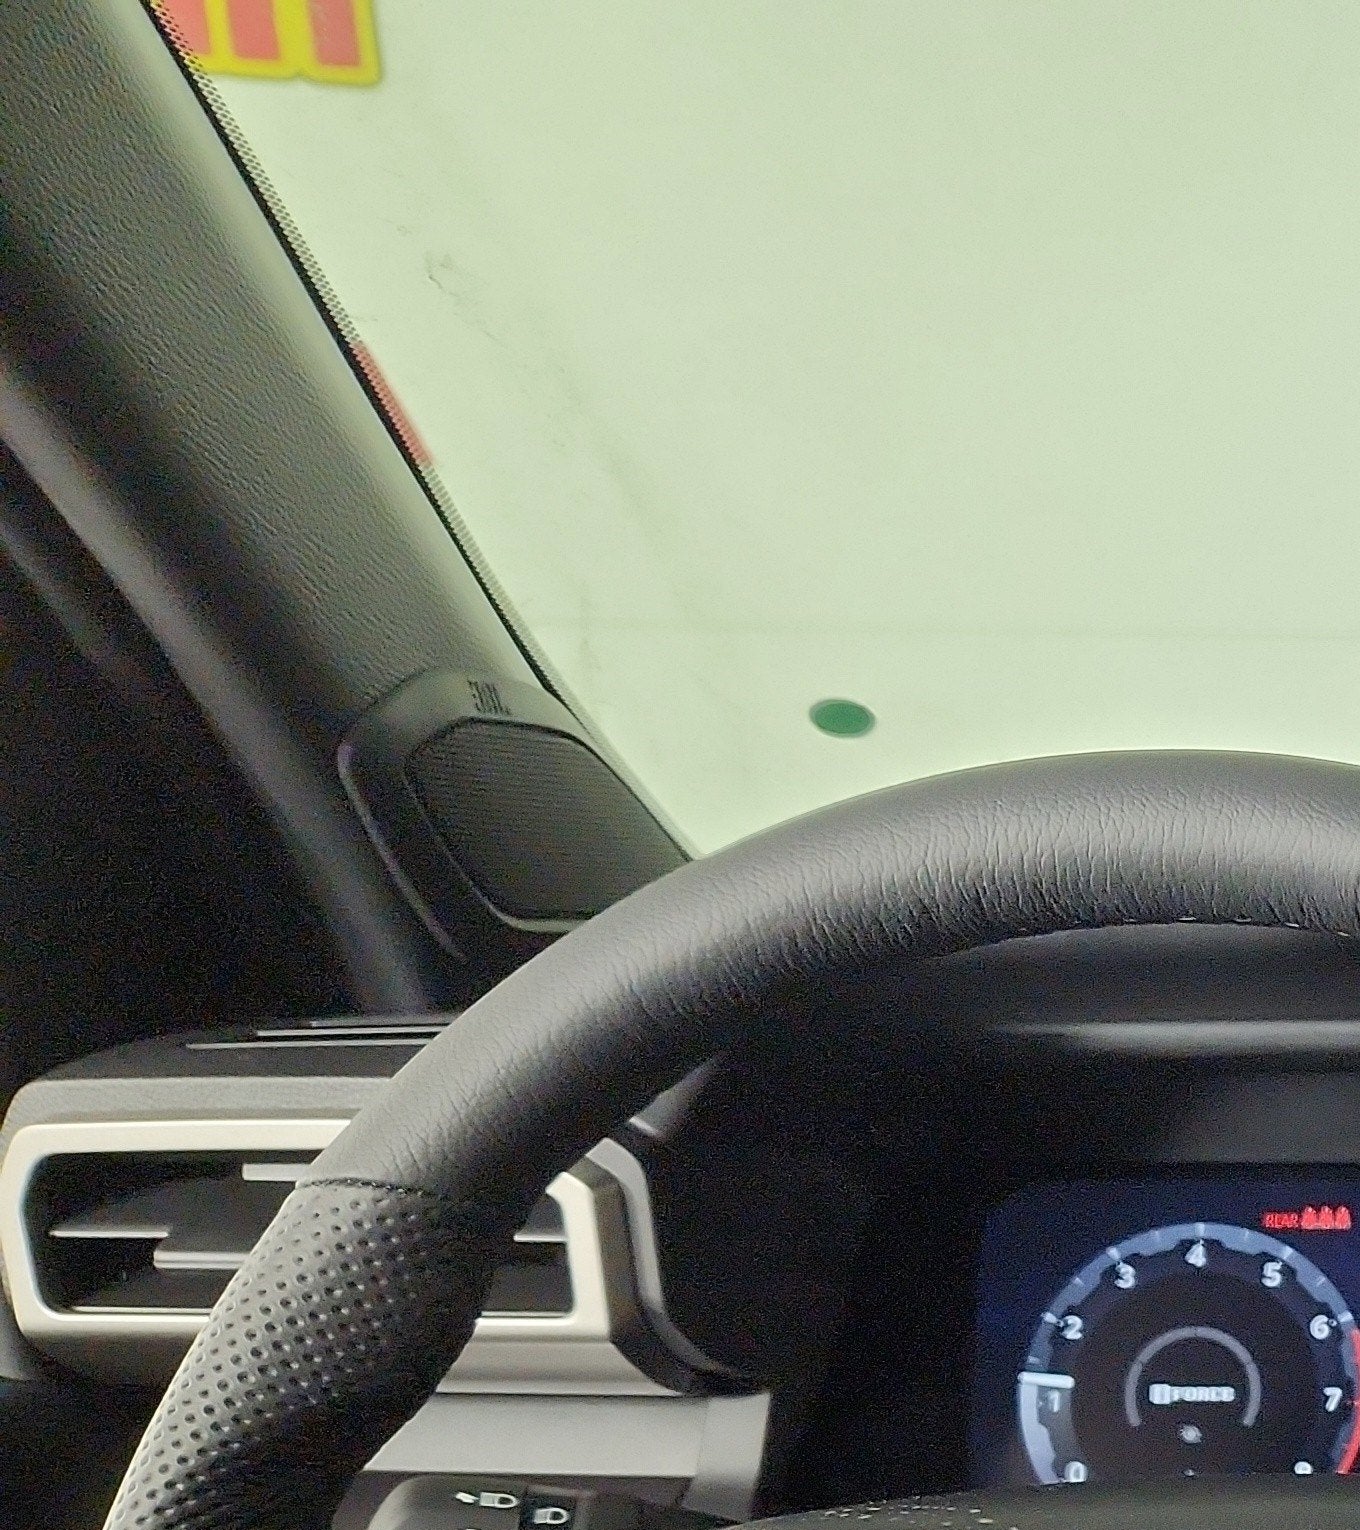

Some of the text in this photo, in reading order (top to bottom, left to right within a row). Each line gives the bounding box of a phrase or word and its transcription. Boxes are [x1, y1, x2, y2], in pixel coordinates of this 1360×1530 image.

[1184, 1241, 1207, 1268] 4
[1114, 1262, 1137, 1289] 3
[1260, 1261, 1284, 1288] 5
[1062, 1314, 1084, 1340] 2
[1308, 1314, 1331, 1340] 6
[1323, 1387, 1343, 1412] 7
